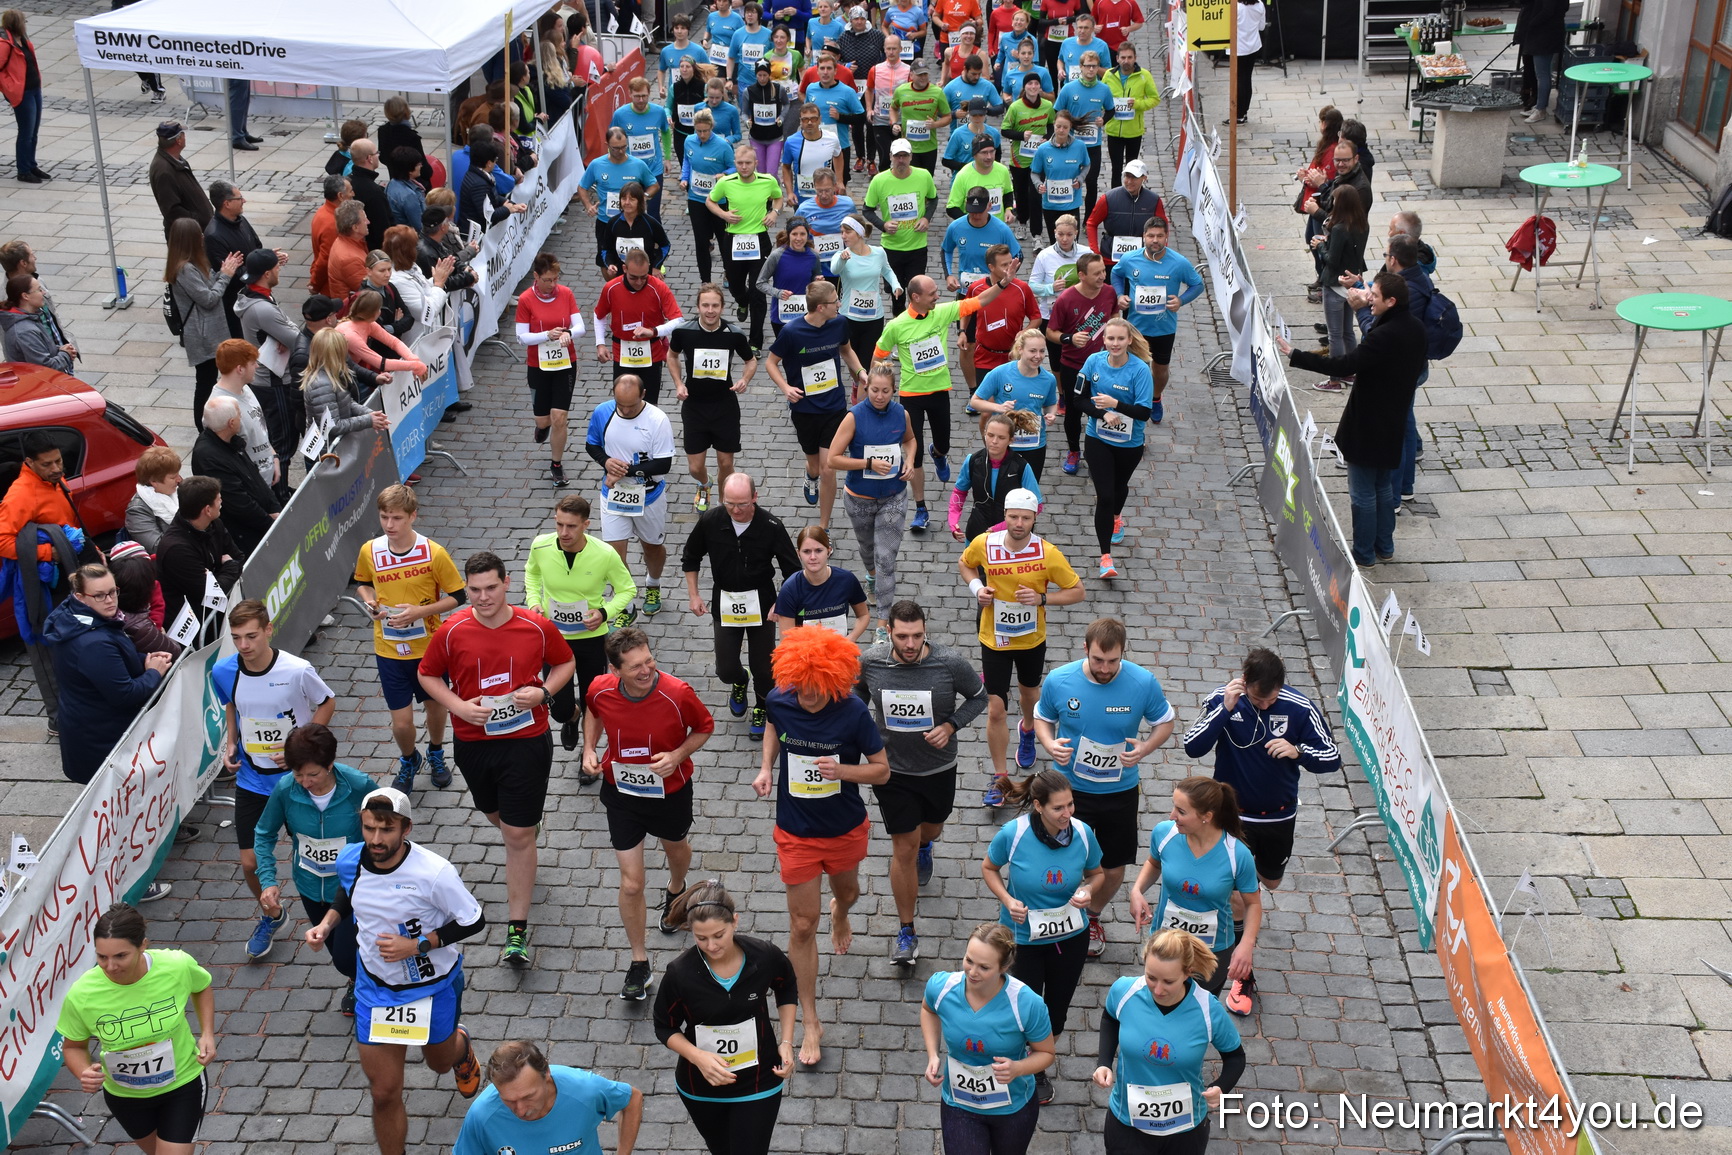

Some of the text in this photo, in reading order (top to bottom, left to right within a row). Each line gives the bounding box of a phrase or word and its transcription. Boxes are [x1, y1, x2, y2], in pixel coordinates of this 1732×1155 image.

[1202, 8, 1223, 20] lauf
[94, 31, 286, 58] BMW ConnectedDrive
[97, 50, 244, 70] Vernetzt, um frei zu sein.
[712, 50, 726, 58] 2405
[632, 142, 651, 150] 2486
[694, 178, 712, 188] 2463
[893, 202, 914, 212] 2483
[736, 242, 756, 250] 2035
[818, 242, 840, 252] 2335
[1116, 244, 1138, 252] 2600
[854, 298, 874, 308] 2258
[1140, 295, 1162, 304] 2487
[784, 304, 805, 312] 2904
[546, 349, 562, 360] 125
[628, 347, 644, 356] 126
[916, 346, 940, 361] 2528
[702, 358, 720, 369] 413
[814, 372, 826, 382] 32
[306, 436, 318, 454] swn
[613, 490, 640, 504] 2238
[376, 566, 432, 584] MAX BÖGL
[988, 563, 1046, 576] MAX BÖGL
[266, 550, 304, 622] OCK
[732, 603, 746, 614] 85
[554, 610, 582, 622] 2998
[1000, 612, 1031, 624] 2610
[177, 618, 192, 638] swn
[890, 704, 925, 717] 2524
[255, 730, 282, 742] 182
[786, 737, 808, 747] GOSSEN
[1084, 752, 1117, 768] 2072
[620, 770, 656, 786] 2534
[804, 770, 822, 783] 35
[1086, 768, 1110, 776] Johannes
[306, 844, 338, 862] 2485
[1038, 916, 1074, 936] 2011
[1170, 917, 1208, 934] 2402
[96, 996, 178, 1042] OPF
[385, 1006, 416, 1024] 215
[1486, 1001, 1494, 1016] für
[1494, 1016, 1502, 1028] die
[1497, 996, 1519, 1044] Neumarkts
[390, 1027, 410, 1035] Daniel
[716, 1039, 738, 1054] 20
[116, 1056, 164, 1075] 2717
[956, 1074, 996, 1093] 2451
[1138, 1100, 1184, 1118] 2370
[550, 1140, 582, 1154] BOCK
